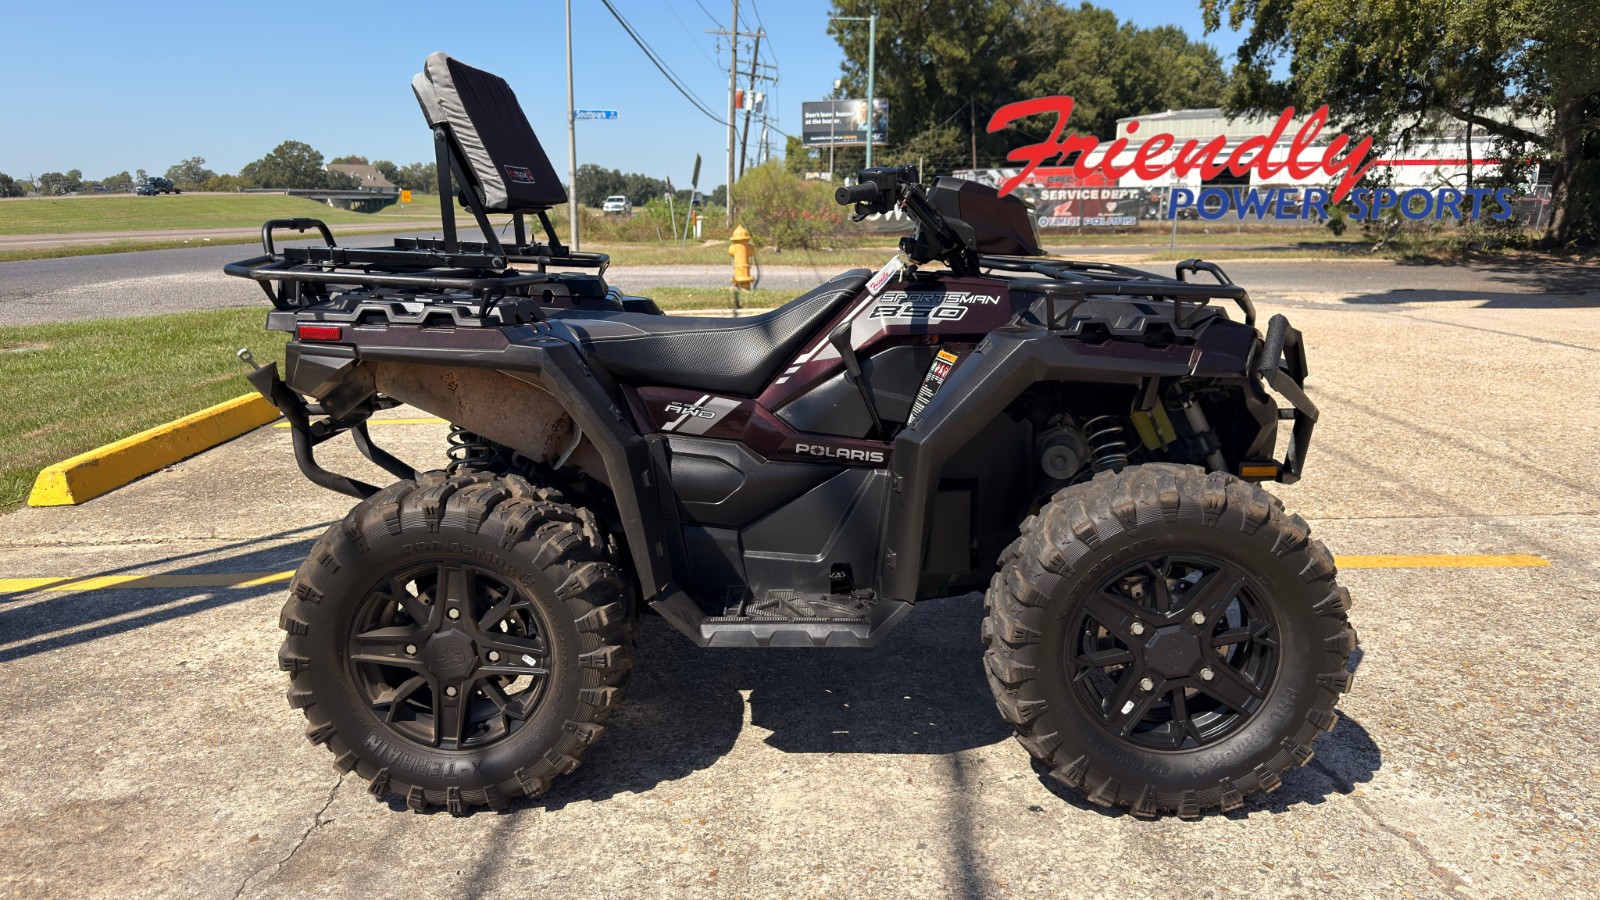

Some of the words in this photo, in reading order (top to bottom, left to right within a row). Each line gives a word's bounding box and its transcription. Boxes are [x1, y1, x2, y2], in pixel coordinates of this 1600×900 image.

[1040, 189, 1099, 200] SERVICE
[1101, 189, 1140, 199] DEPT.
[880, 293, 1001, 305] SPORTSMAN
[868, 305, 968, 320] 850
[664, 404, 716, 419] AWD
[795, 443, 884, 463] POLARIS
[361, 731, 486, 781] X-TERRAIN
